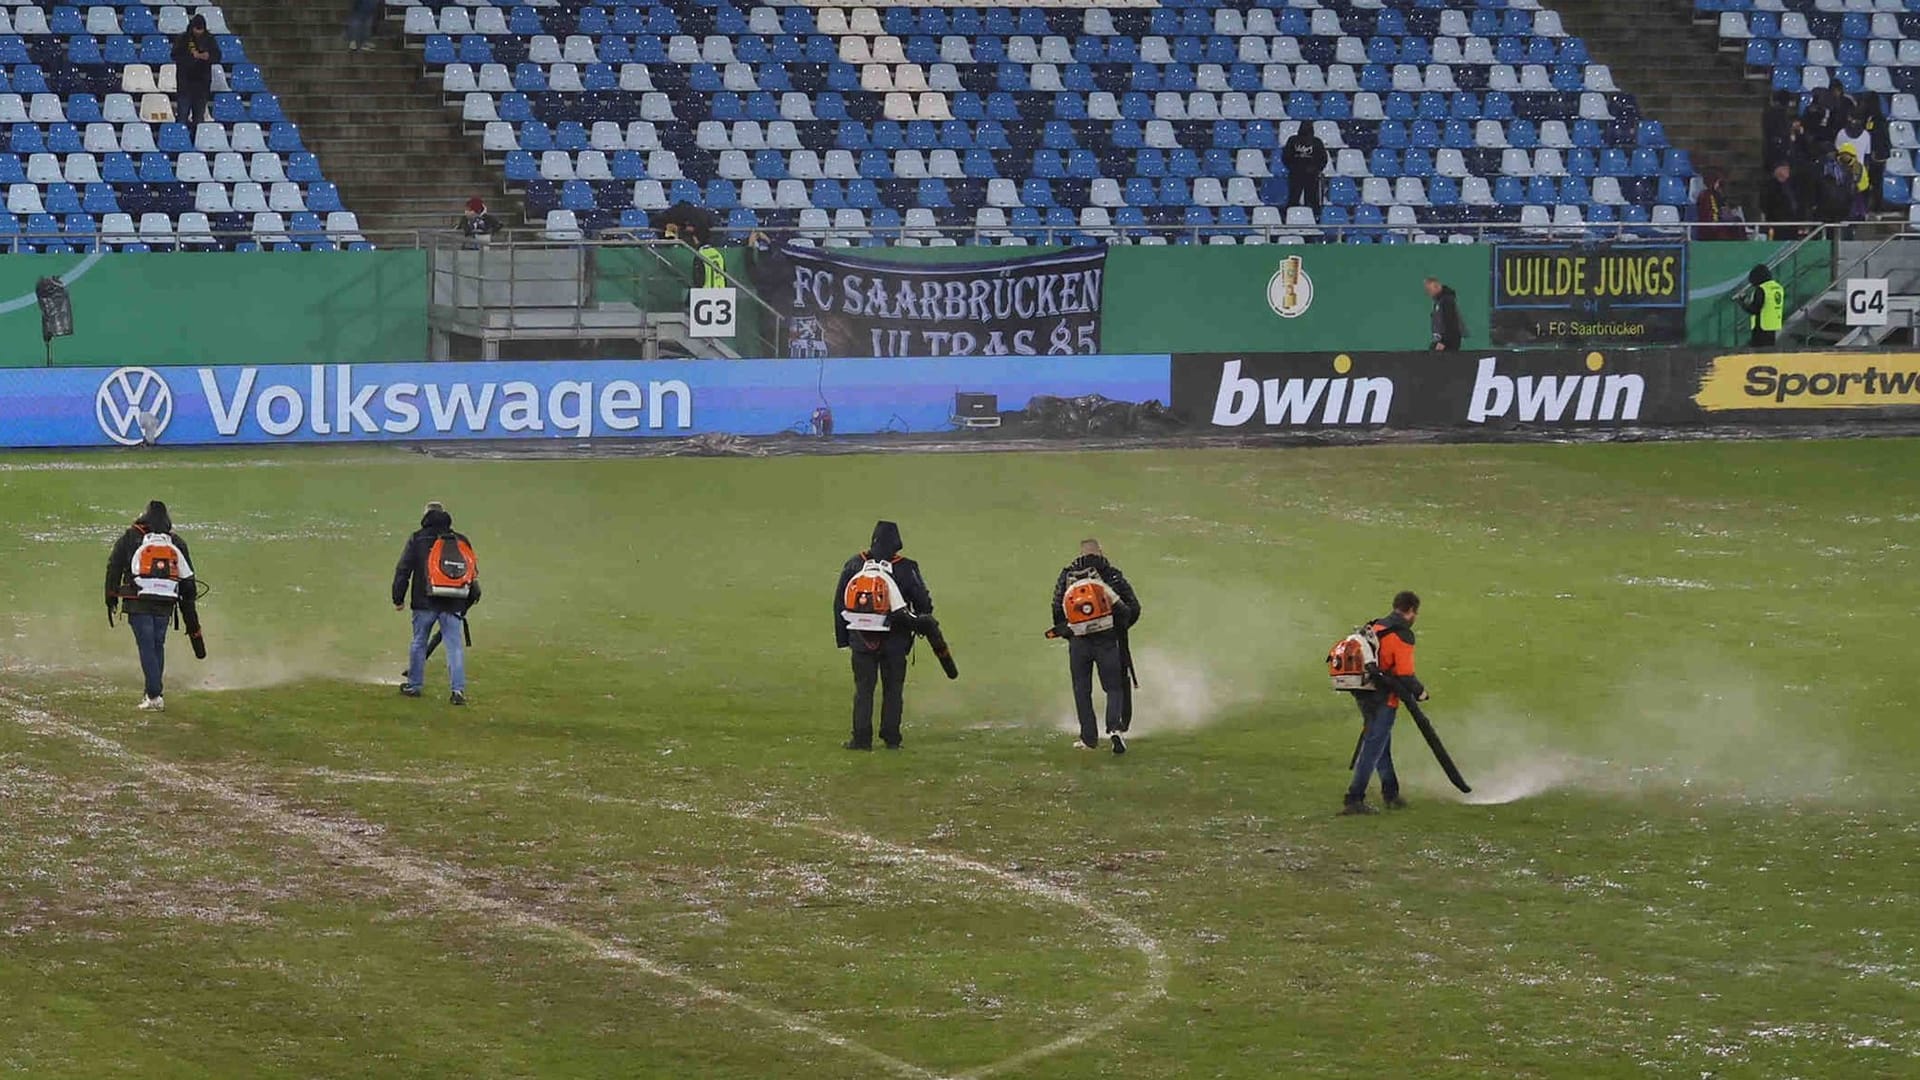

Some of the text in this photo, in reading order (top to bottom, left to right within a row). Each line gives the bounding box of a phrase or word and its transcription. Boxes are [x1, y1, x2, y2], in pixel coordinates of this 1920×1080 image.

[793, 264, 1102, 323] FC SAARBRÜCKEN
[1505, 256, 1675, 296] WILDE JUNGS
[693, 299, 732, 326] G3
[1849, 289, 1885, 314] G4
[1549, 321, 1567, 336] FC
[198, 364, 692, 438] Volkswagen
[1211, 353, 1394, 426] bwin
[1467, 351, 1645, 423] bwin
[1744, 365, 1920, 402] Sportw
